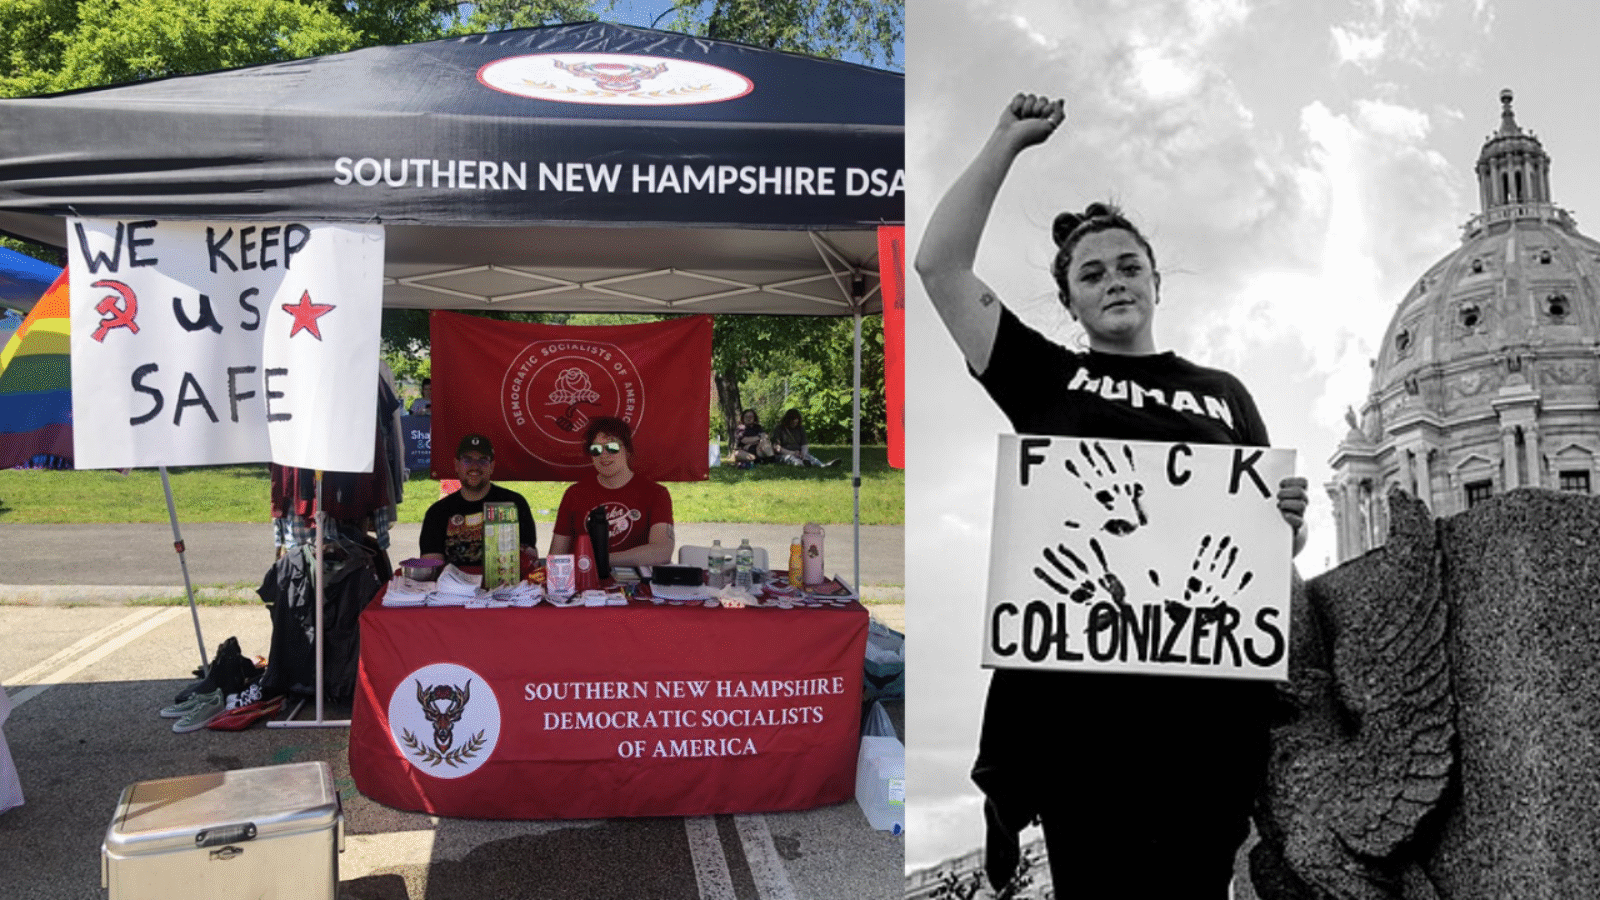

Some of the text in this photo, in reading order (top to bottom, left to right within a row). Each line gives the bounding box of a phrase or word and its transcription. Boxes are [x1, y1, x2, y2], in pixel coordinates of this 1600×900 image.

[334, 156, 905, 198] SOUTHERN NEW HAMPSHIRE DSA
[74, 219, 311, 274] WE KEEP
[129, 362, 293, 427] SAFE
[510, 343, 636, 427] DEMOCRATIC SOCIALISTS OF AMERIC
[1067, 366, 1235, 430] HUMAN
[990, 600, 1286, 668] COLONIZERS
[524, 676, 845, 701] SOUTHERN NEW HAMPSHIRE
[543, 706, 824, 731] DEMOCRATIC SOCIALISTS
[617, 738, 757, 760] OF AMERICA
